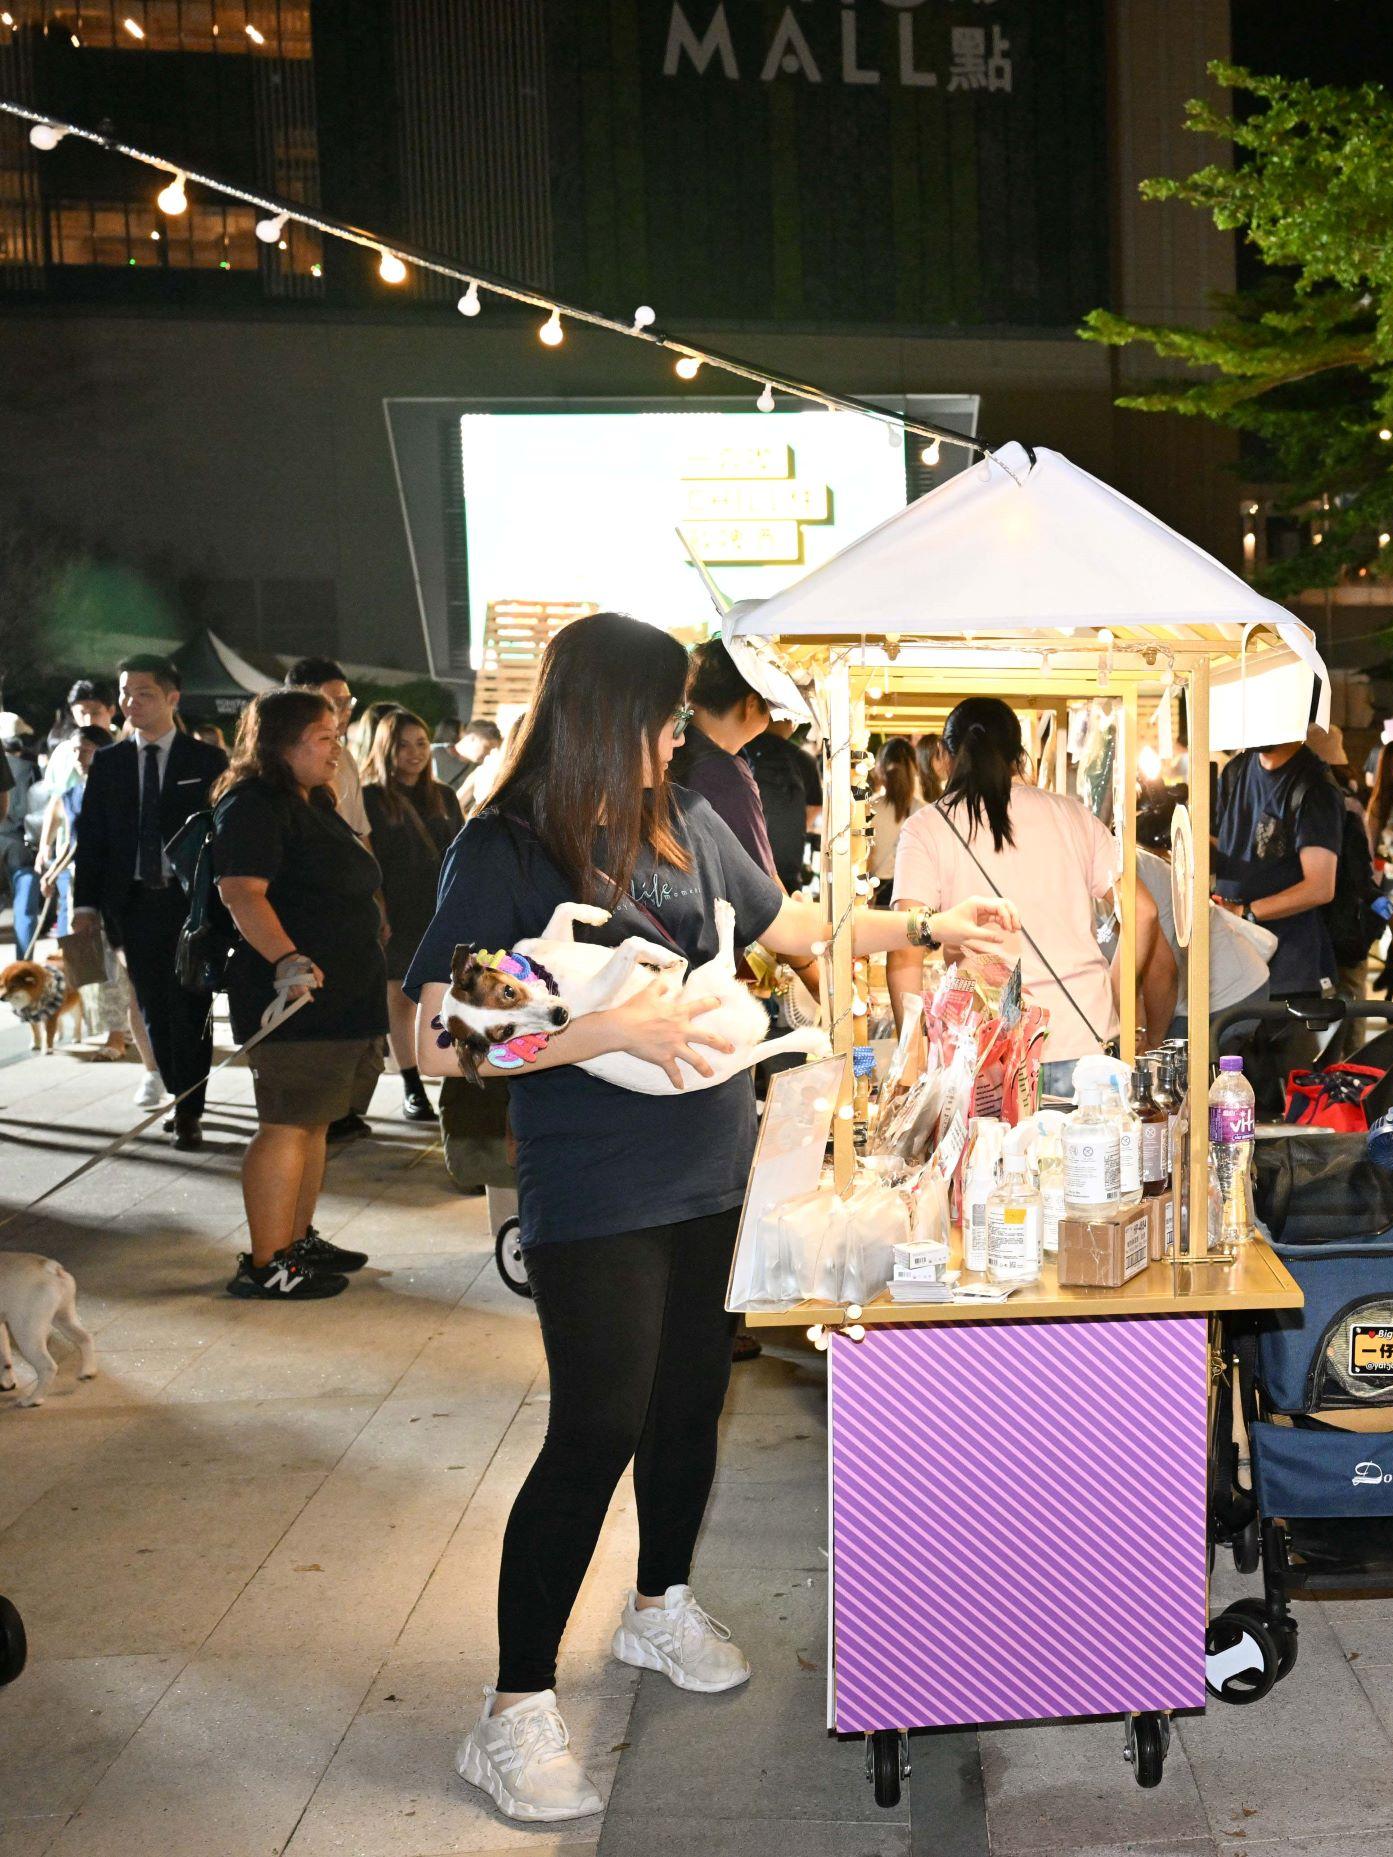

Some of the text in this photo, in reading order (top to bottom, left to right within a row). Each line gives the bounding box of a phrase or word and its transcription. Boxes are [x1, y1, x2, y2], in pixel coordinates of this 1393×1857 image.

[663, 2, 937, 87] MALL
[947, 25, 1013, 93] 點
[1378, 1329, 1393, 1340] Big
